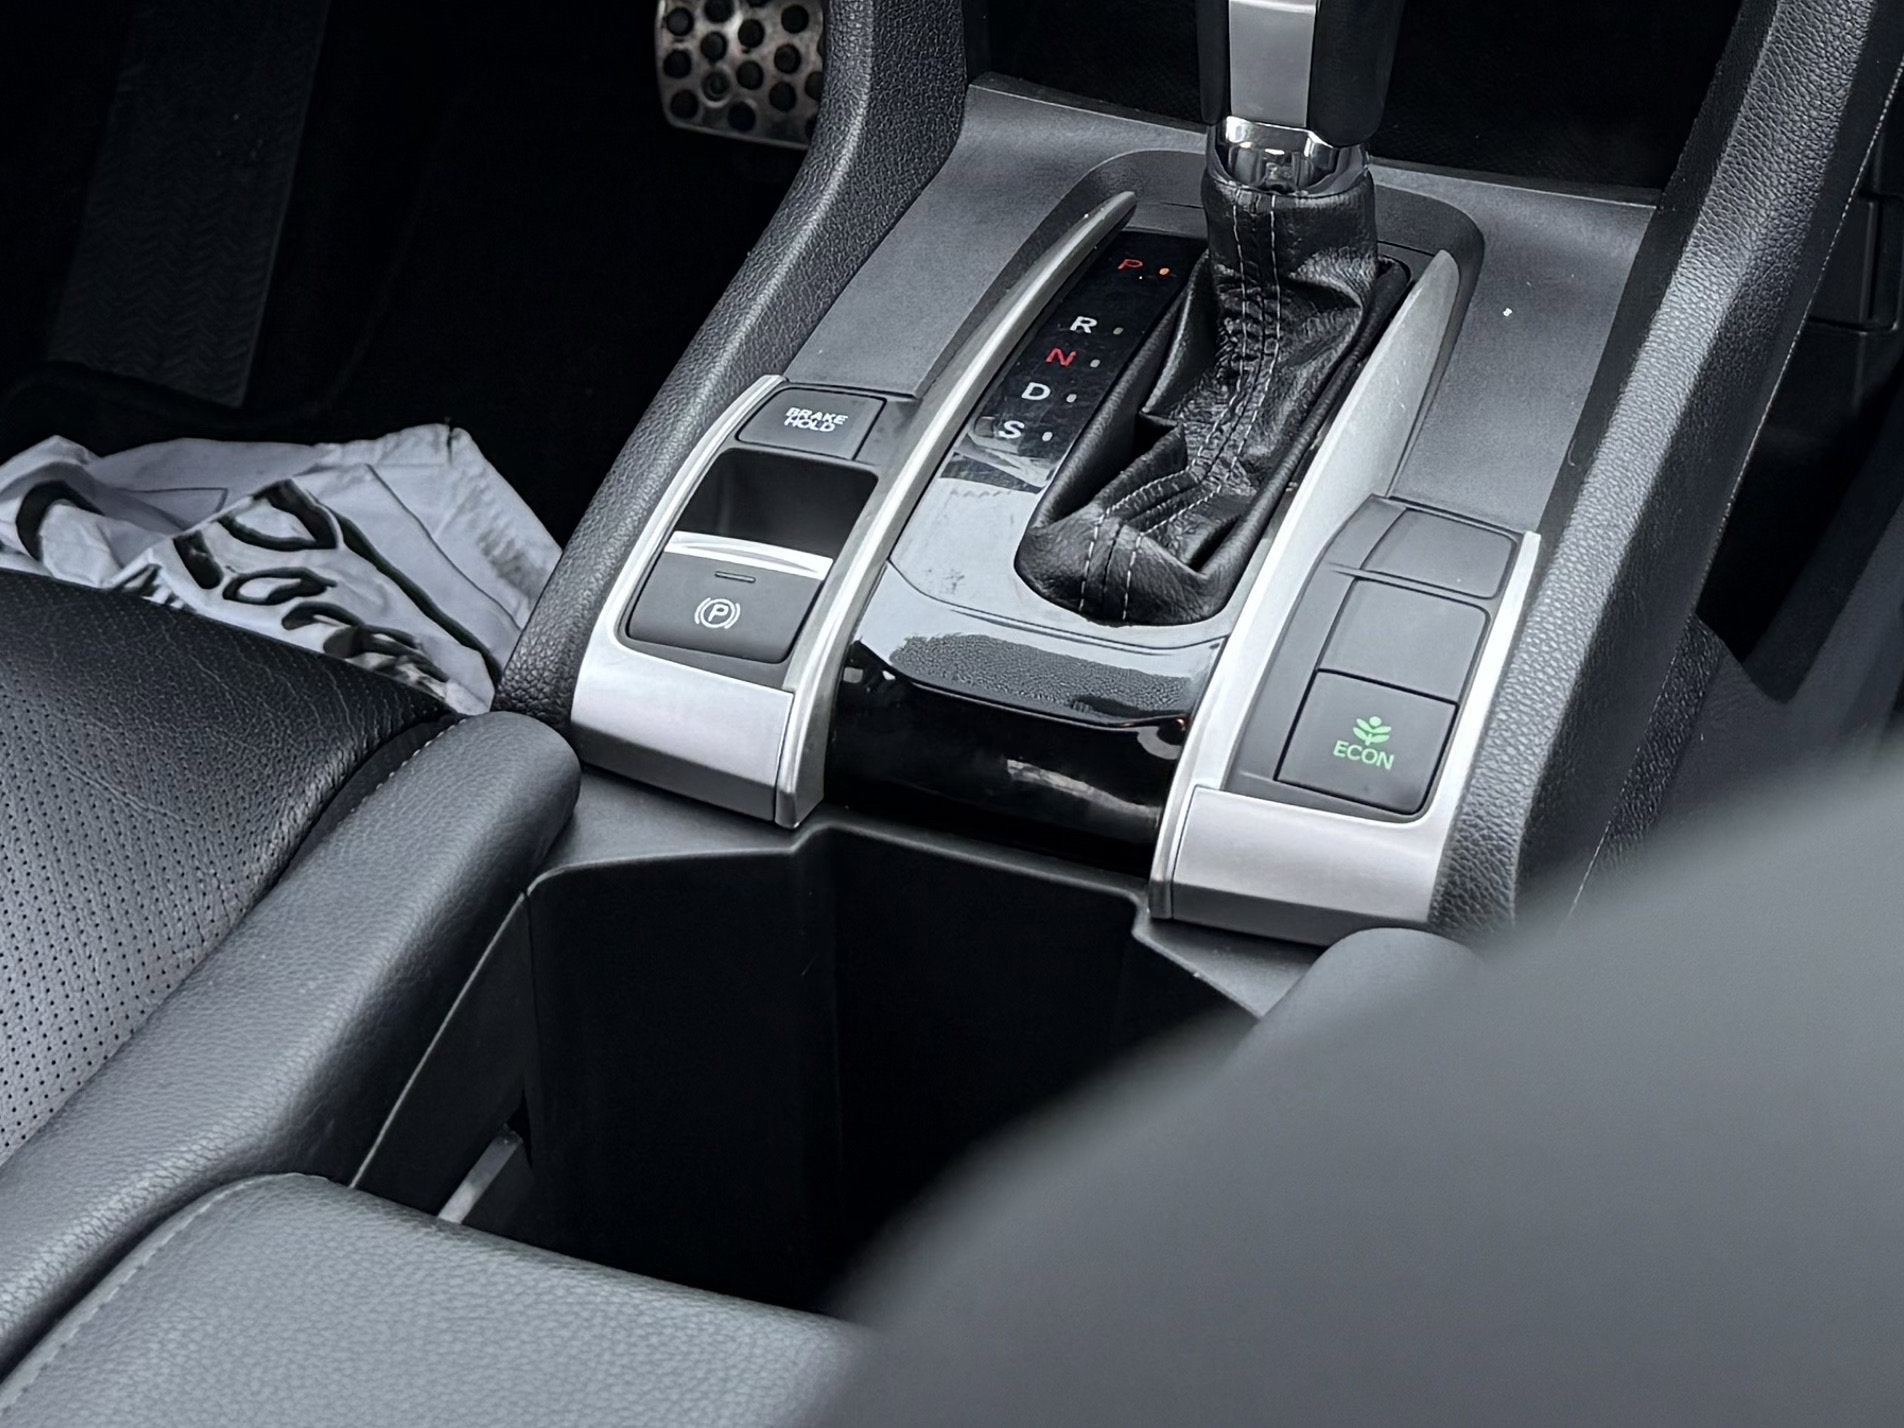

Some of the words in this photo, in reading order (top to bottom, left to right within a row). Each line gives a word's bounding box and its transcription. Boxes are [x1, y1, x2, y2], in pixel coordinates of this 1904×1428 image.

[1116, 257, 1144, 271] P
[1069, 315, 1098, 334] R
[1046, 347, 1077, 366] N
[1021, 381, 1052, 401] D
[783, 416, 837, 434] HOLD
[785, 406, 848, 426] BRAKE
[998, 420, 1026, 439] S
[1333, 739, 1395, 770] ECON
